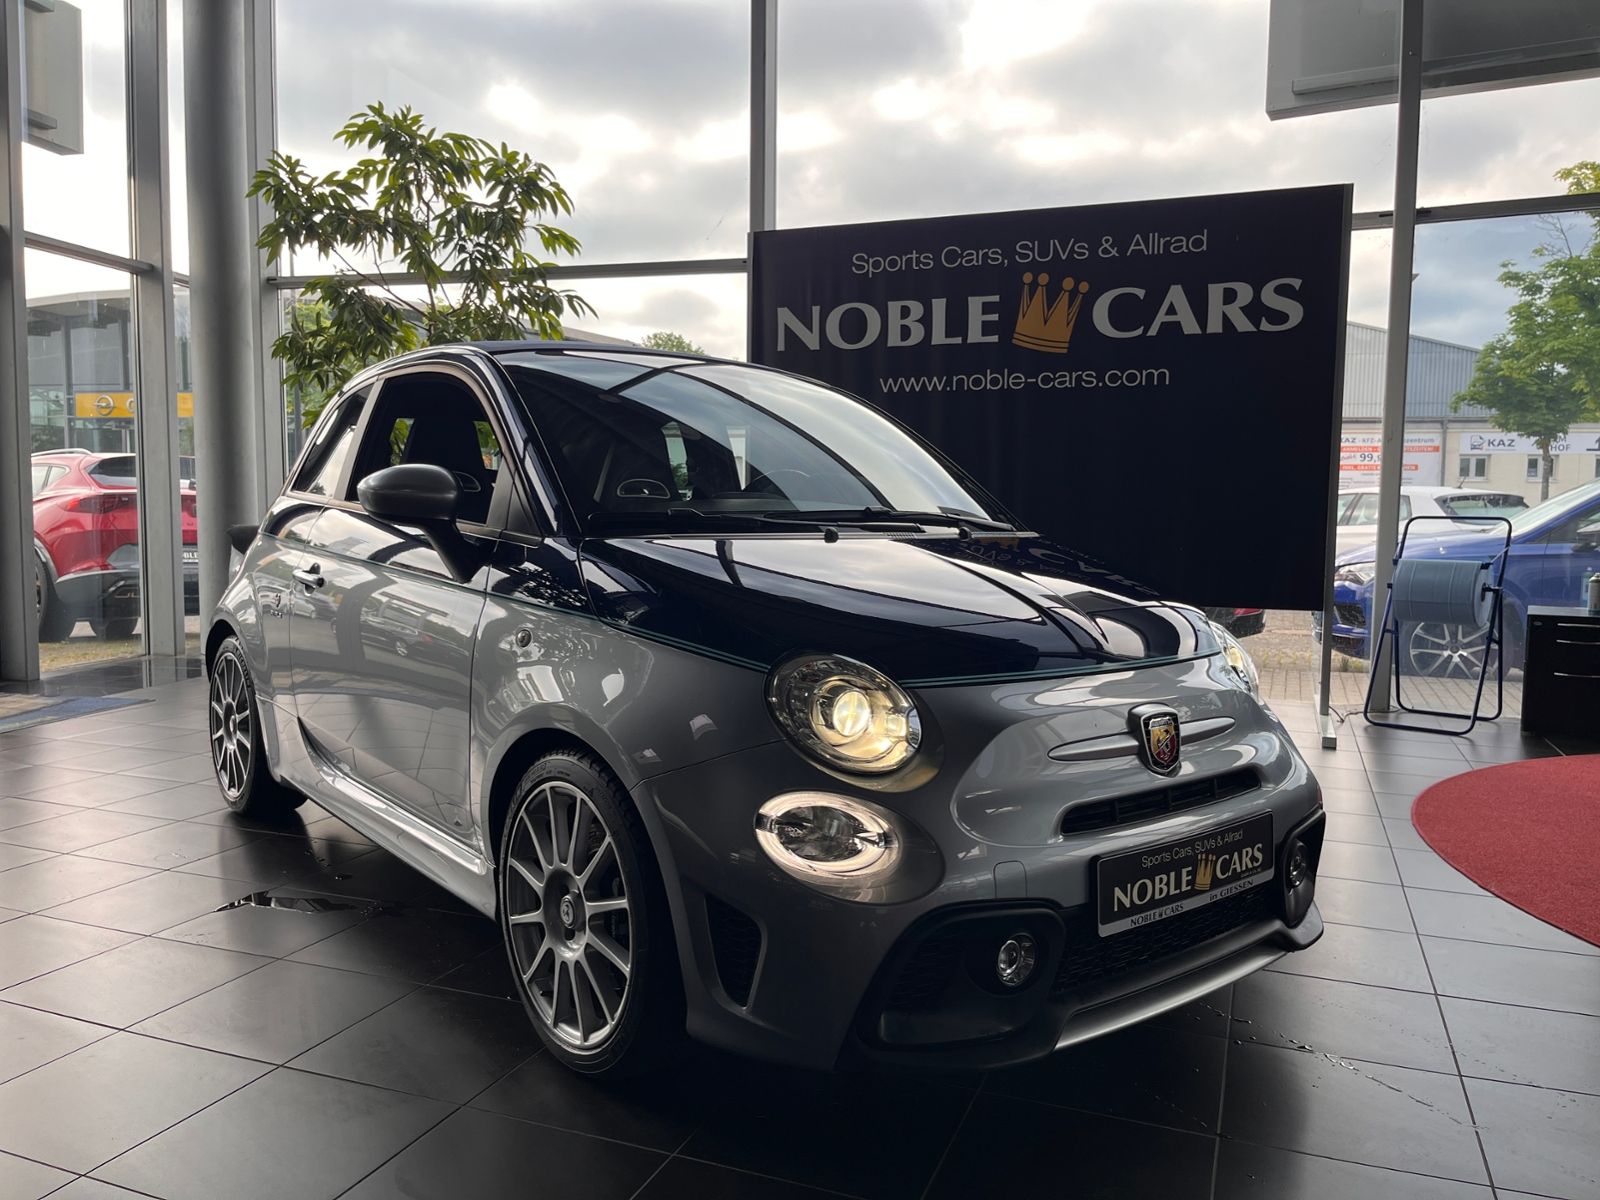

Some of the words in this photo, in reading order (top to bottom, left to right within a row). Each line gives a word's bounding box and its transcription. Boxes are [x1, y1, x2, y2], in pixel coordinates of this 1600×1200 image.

[852, 250, 934, 278] Sports
[941, 246, 1008, 268] Cars,
[1015, 238, 1089, 263] SUVs
[1098, 236, 1119, 257] &
[1127, 229, 1207, 256] Allrad
[777, 295, 1000, 351] NOBLE
[1092, 277, 1304, 338] CARS
[880, 368, 1170, 393] www.noble-cars.com
[1488, 439, 1515, 447] KAZ
[1142, 851, 1171, 868] Sports
[1195, 838, 1216, 853] SUVs
[1216, 835, 1223, 846] &
[1224, 828, 1243, 844] Allrad
[1113, 867, 1192, 912] NOBLE
[1216, 844, 1263, 879] CARS
[1209, 892, 1218, 901] in
[1220, 880, 1253, 897] GIESSEN
[1130, 911, 1157, 927] NOBLE
[1164, 904, 1184, 916] CARS
